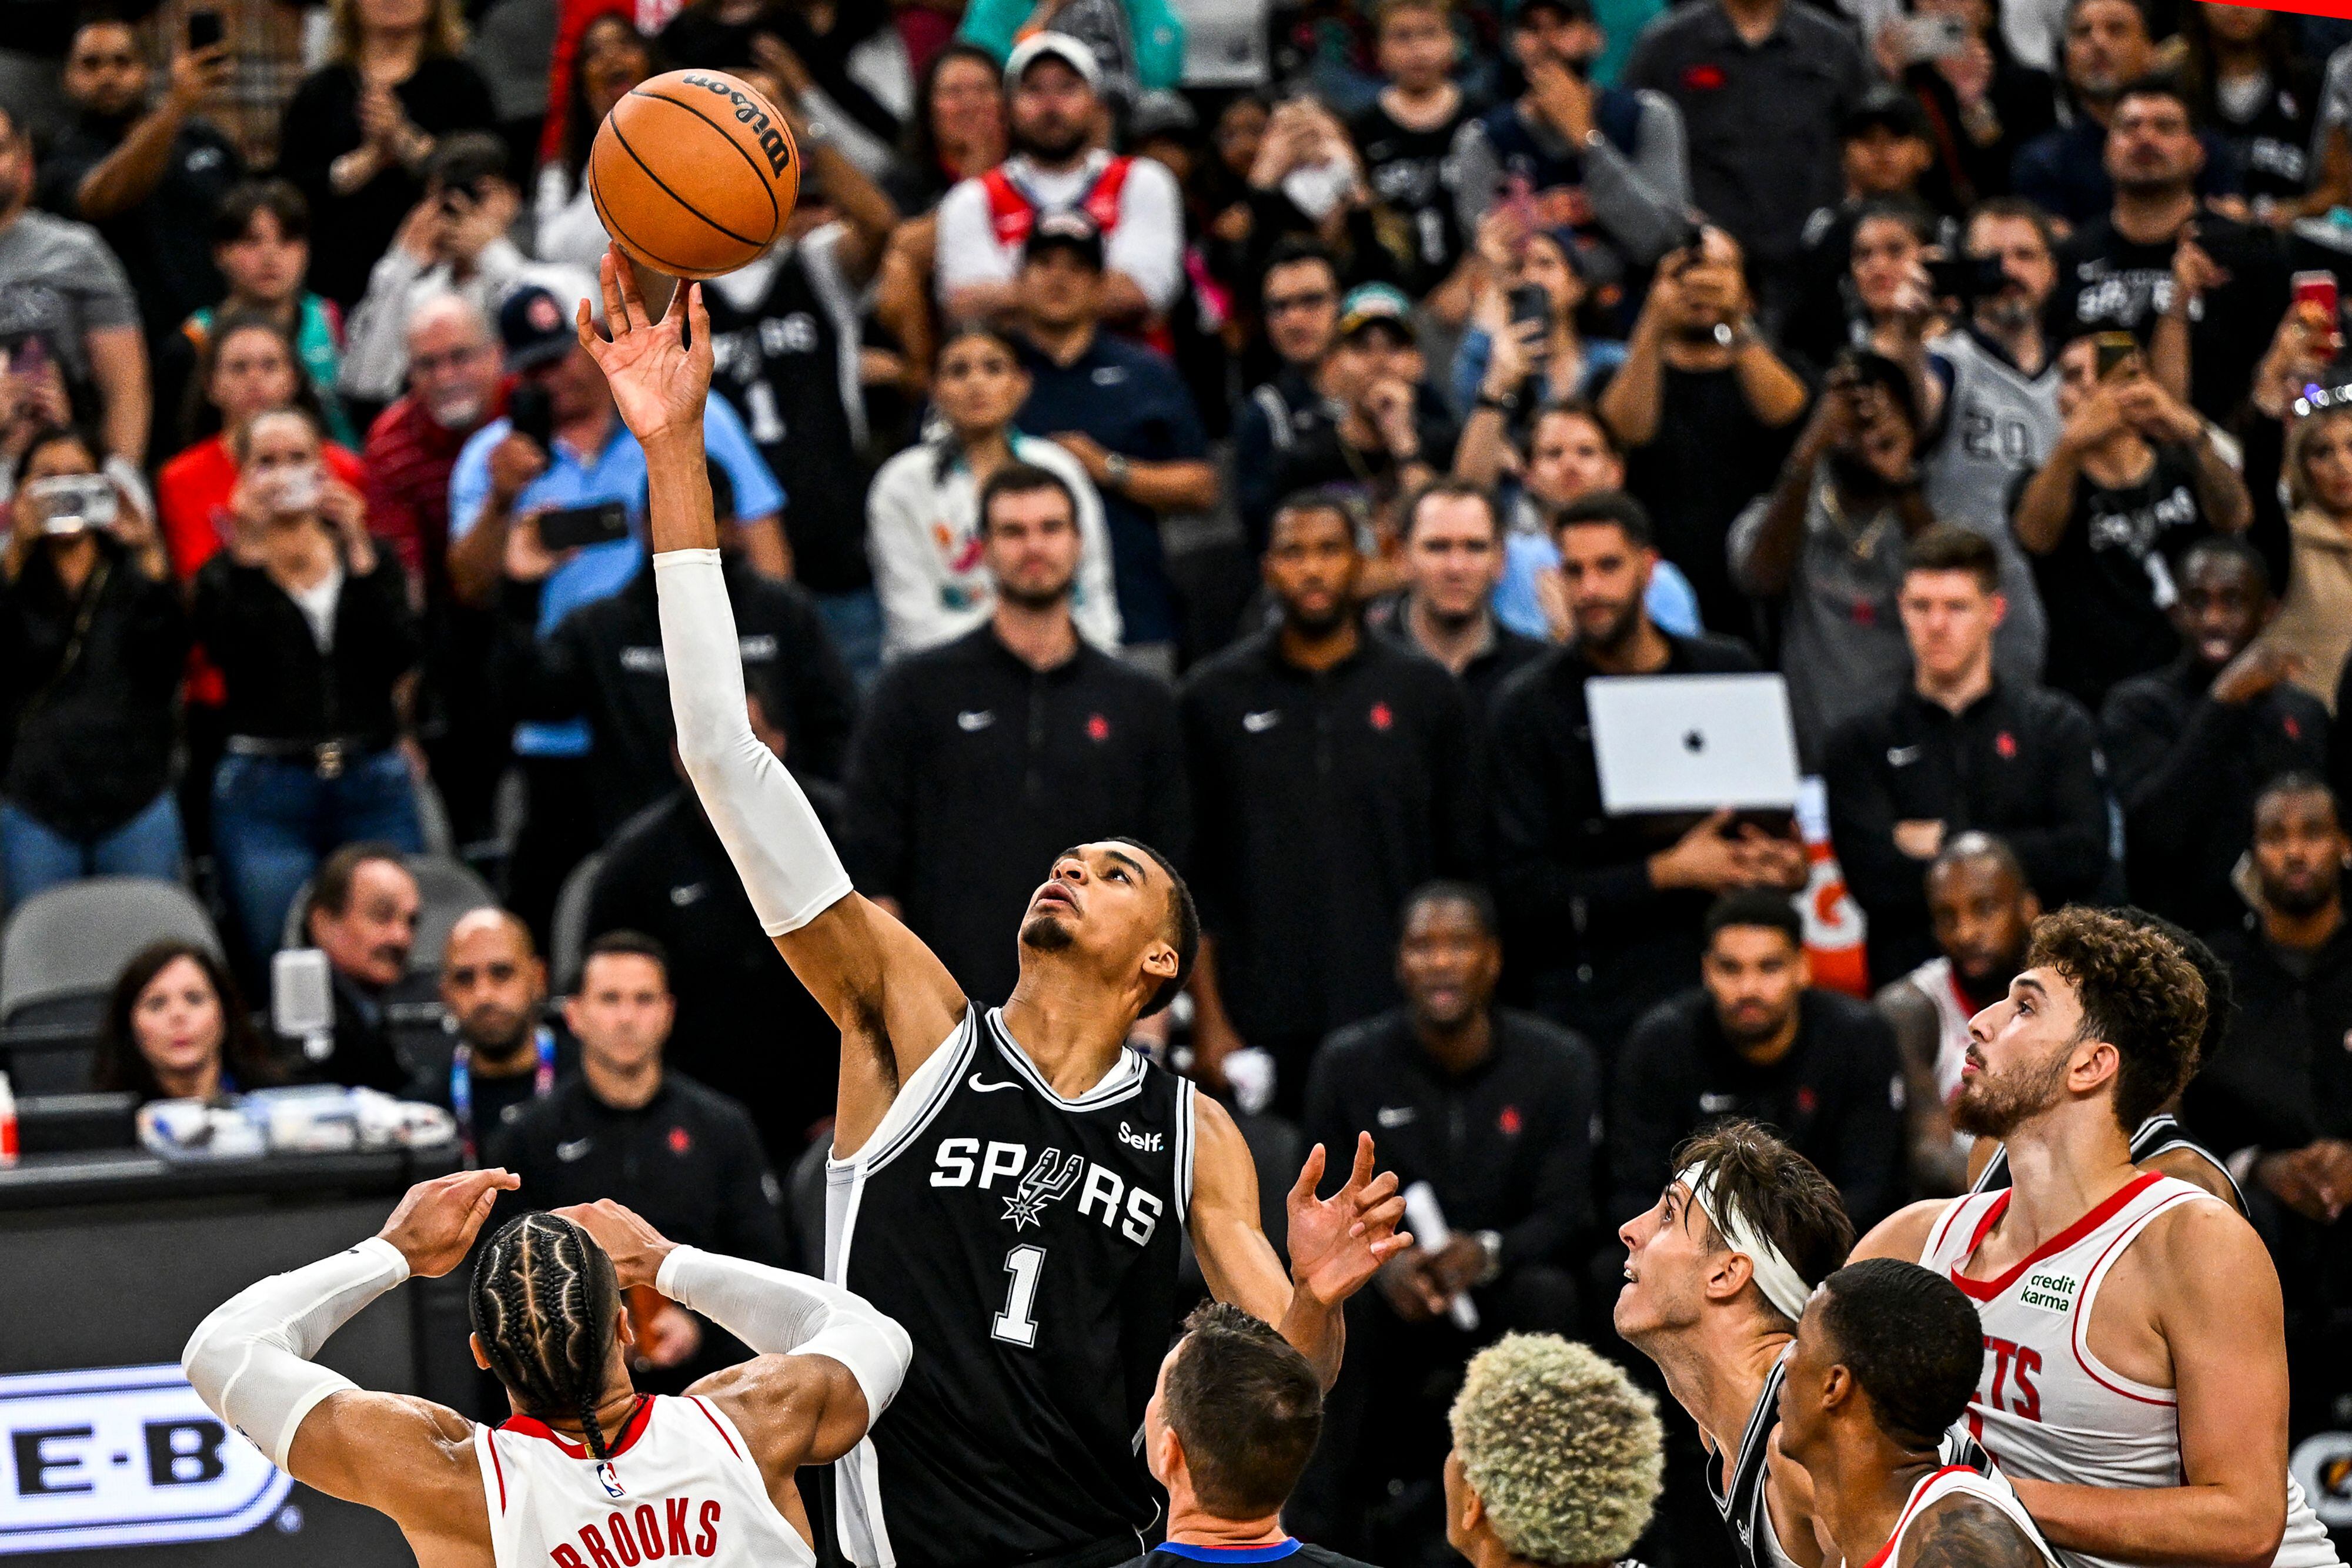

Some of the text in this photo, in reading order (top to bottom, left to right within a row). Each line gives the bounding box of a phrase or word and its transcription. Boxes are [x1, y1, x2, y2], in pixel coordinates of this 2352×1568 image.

[682, 74, 790, 180] Wilson
[1960, 406, 2029, 462] 20
[929, 1137, 1164, 1248] SPURS
[991, 1242, 1047, 1349] 1
[2019, 1285, 2070, 1312] karma
[2030, 1273, 2076, 1295] credit
[1973, 1333, 2043, 1423] TS
[549, 1497, 721, 1568] BROOKS
